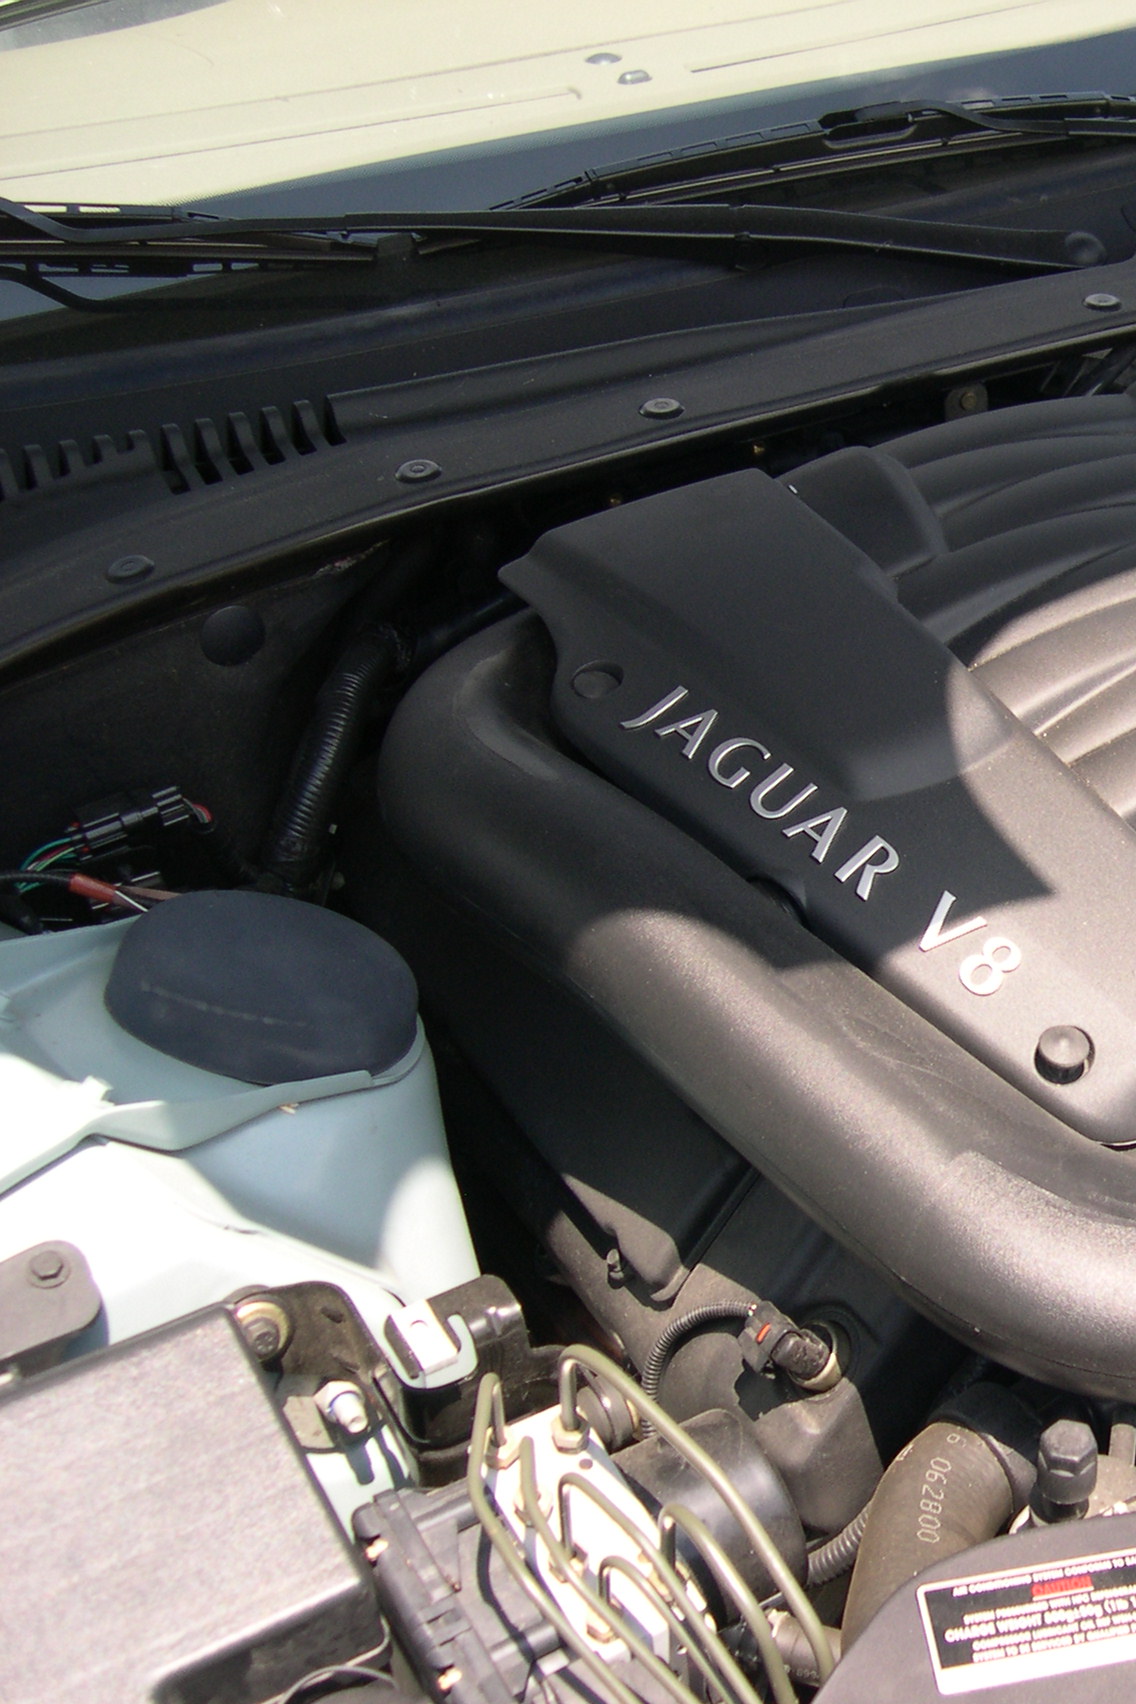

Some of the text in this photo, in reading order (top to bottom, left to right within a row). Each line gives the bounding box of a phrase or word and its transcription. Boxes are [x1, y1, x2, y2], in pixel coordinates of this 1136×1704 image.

[619, 684, 1022, 997] JAGUAR V8
[916, 1457, 952, 1544] 062800
[1031, 1576, 1092, 1596] CAUTION
